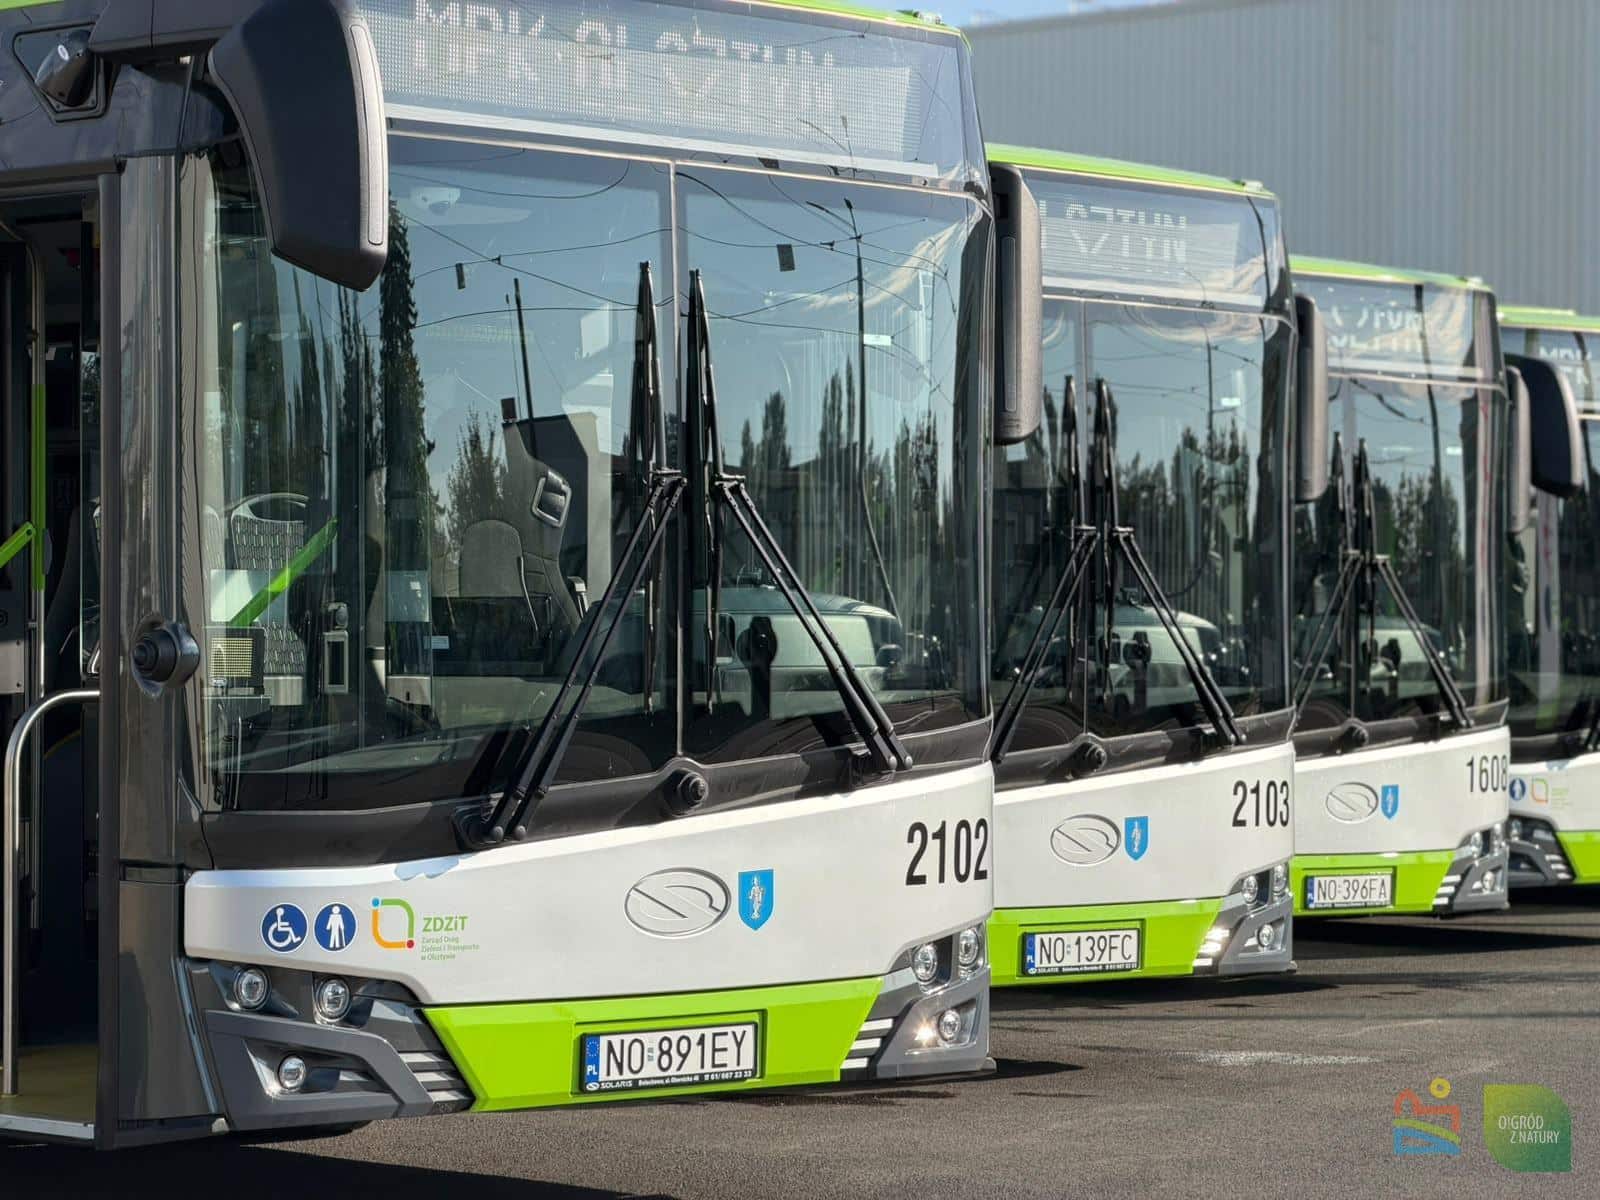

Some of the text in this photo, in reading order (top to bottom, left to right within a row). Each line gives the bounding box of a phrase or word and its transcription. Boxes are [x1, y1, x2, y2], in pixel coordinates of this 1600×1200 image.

[1467, 754, 1508, 793] 1608
[1232, 780, 1290, 827] 2103
[905, 818, 988, 886] 2102
[1317, 878, 1387, 901] NO 396FA
[422, 916, 469, 932] ZDZiT
[1039, 934, 1132, 964] NO 139FC
[606, 1030, 747, 1077] NO 891EY
[586, 1065, 598, 1076] PL
[600, 1080, 633, 1089] SOLARIS
